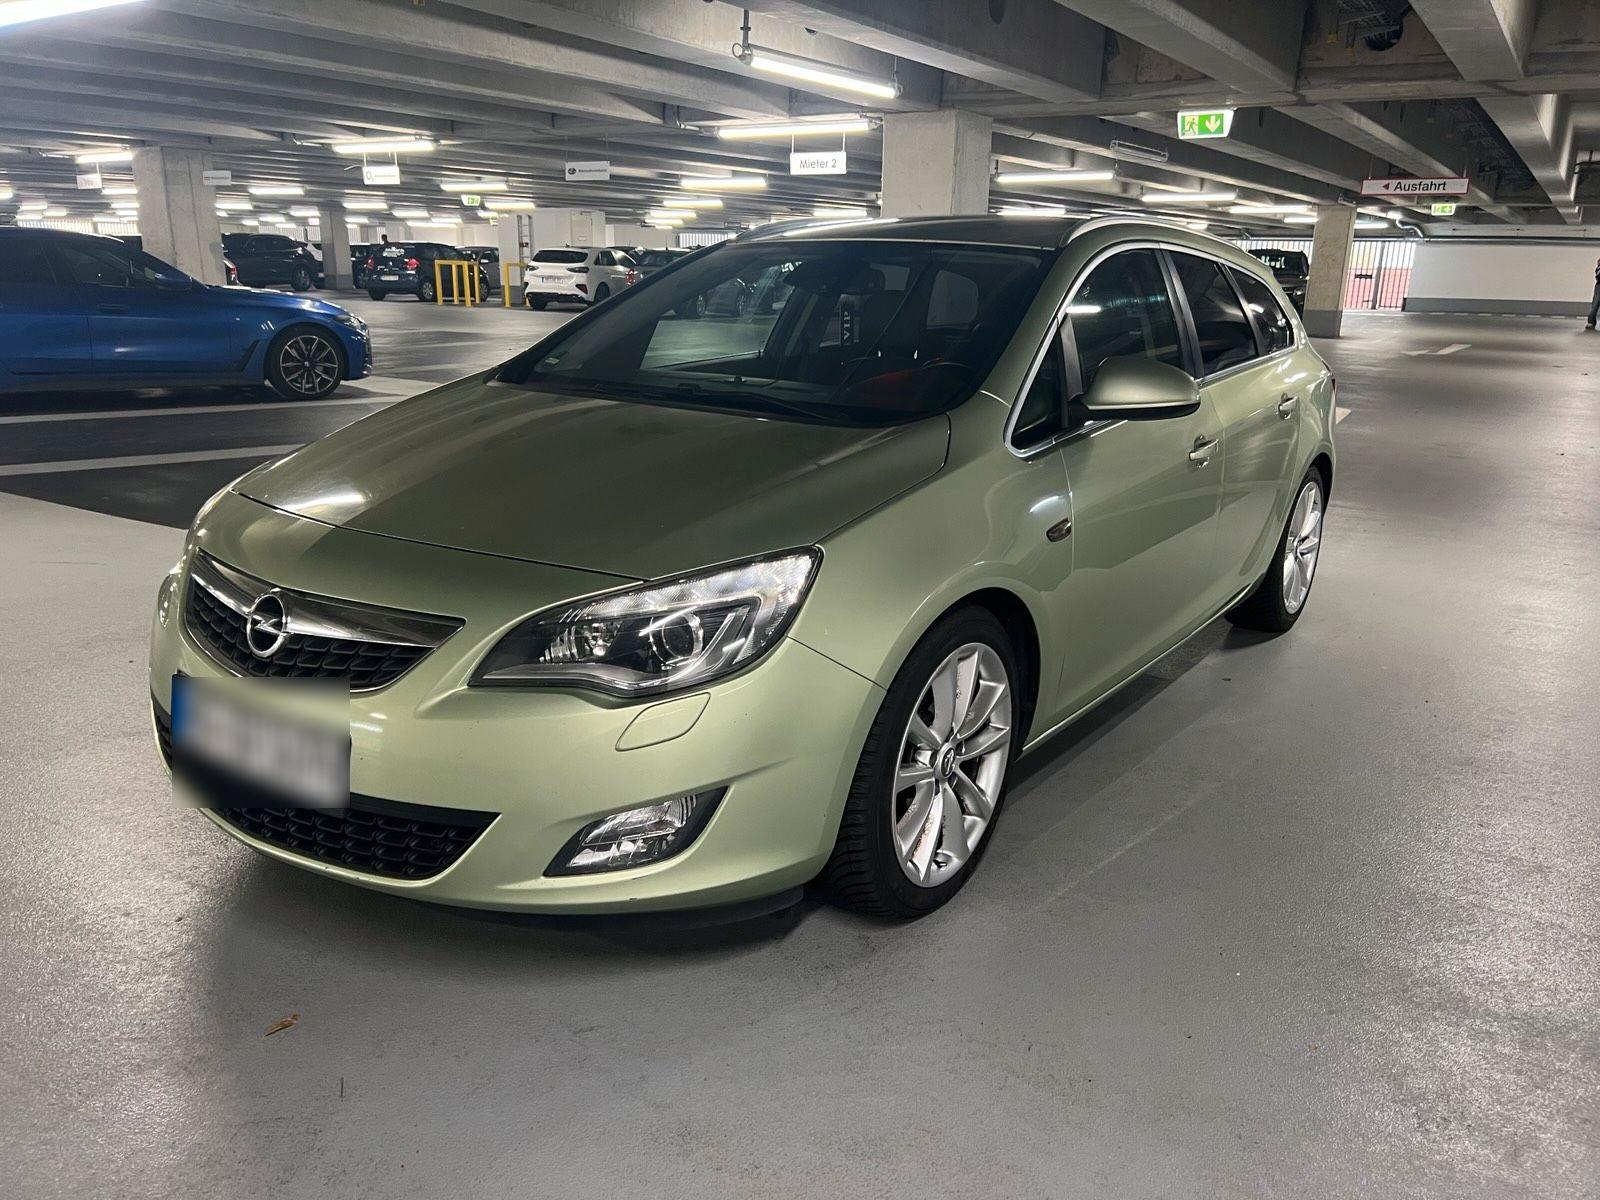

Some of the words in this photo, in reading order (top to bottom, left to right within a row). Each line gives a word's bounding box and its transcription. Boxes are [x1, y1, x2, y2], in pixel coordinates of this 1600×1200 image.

[799, 159, 829, 169] Mieter
[831, 158, 837, 169] 2
[1393, 180, 1447, 192] Ausfahrt
[843, 311, 851, 341] VIP
